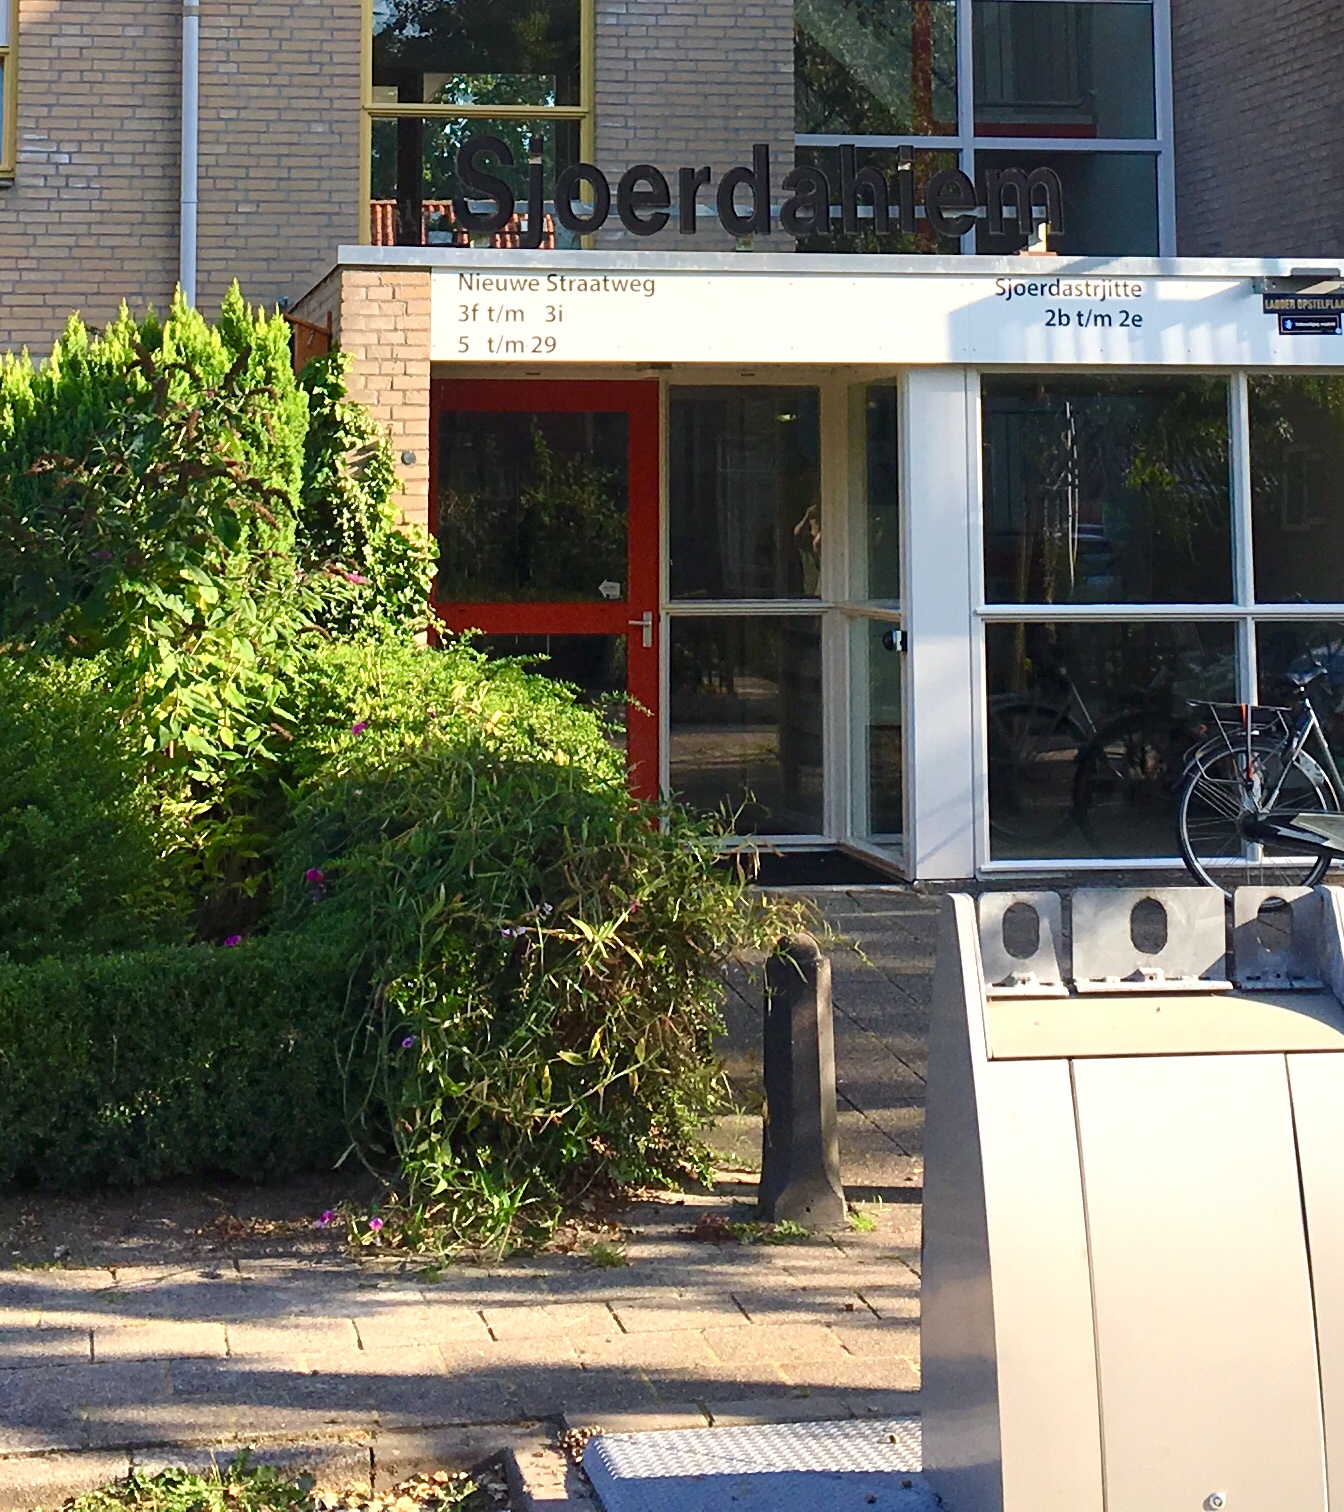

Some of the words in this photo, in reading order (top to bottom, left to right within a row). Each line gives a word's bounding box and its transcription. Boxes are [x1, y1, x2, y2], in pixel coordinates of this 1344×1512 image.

[456, 136, 1065, 249] Sjoerdahiem
[458, 272, 540, 291] Nieuwe
[546, 273, 655, 297] Straatweg
[994, 277, 1142, 302] Sjoerdastrjitte
[458, 303, 479, 322] 3f
[487, 304, 525, 323] t/m
[545, 304, 564, 322] 3i
[1265, 298, 1296, 310] LADDER
[1045, 308, 1071, 326] 2b
[1076, 308, 1112, 328] t/m
[1118, 309, 1144, 327] 2e
[458, 336, 469, 353] 5
[487, 336, 525, 354] t/m
[531, 336, 557, 353] 29
